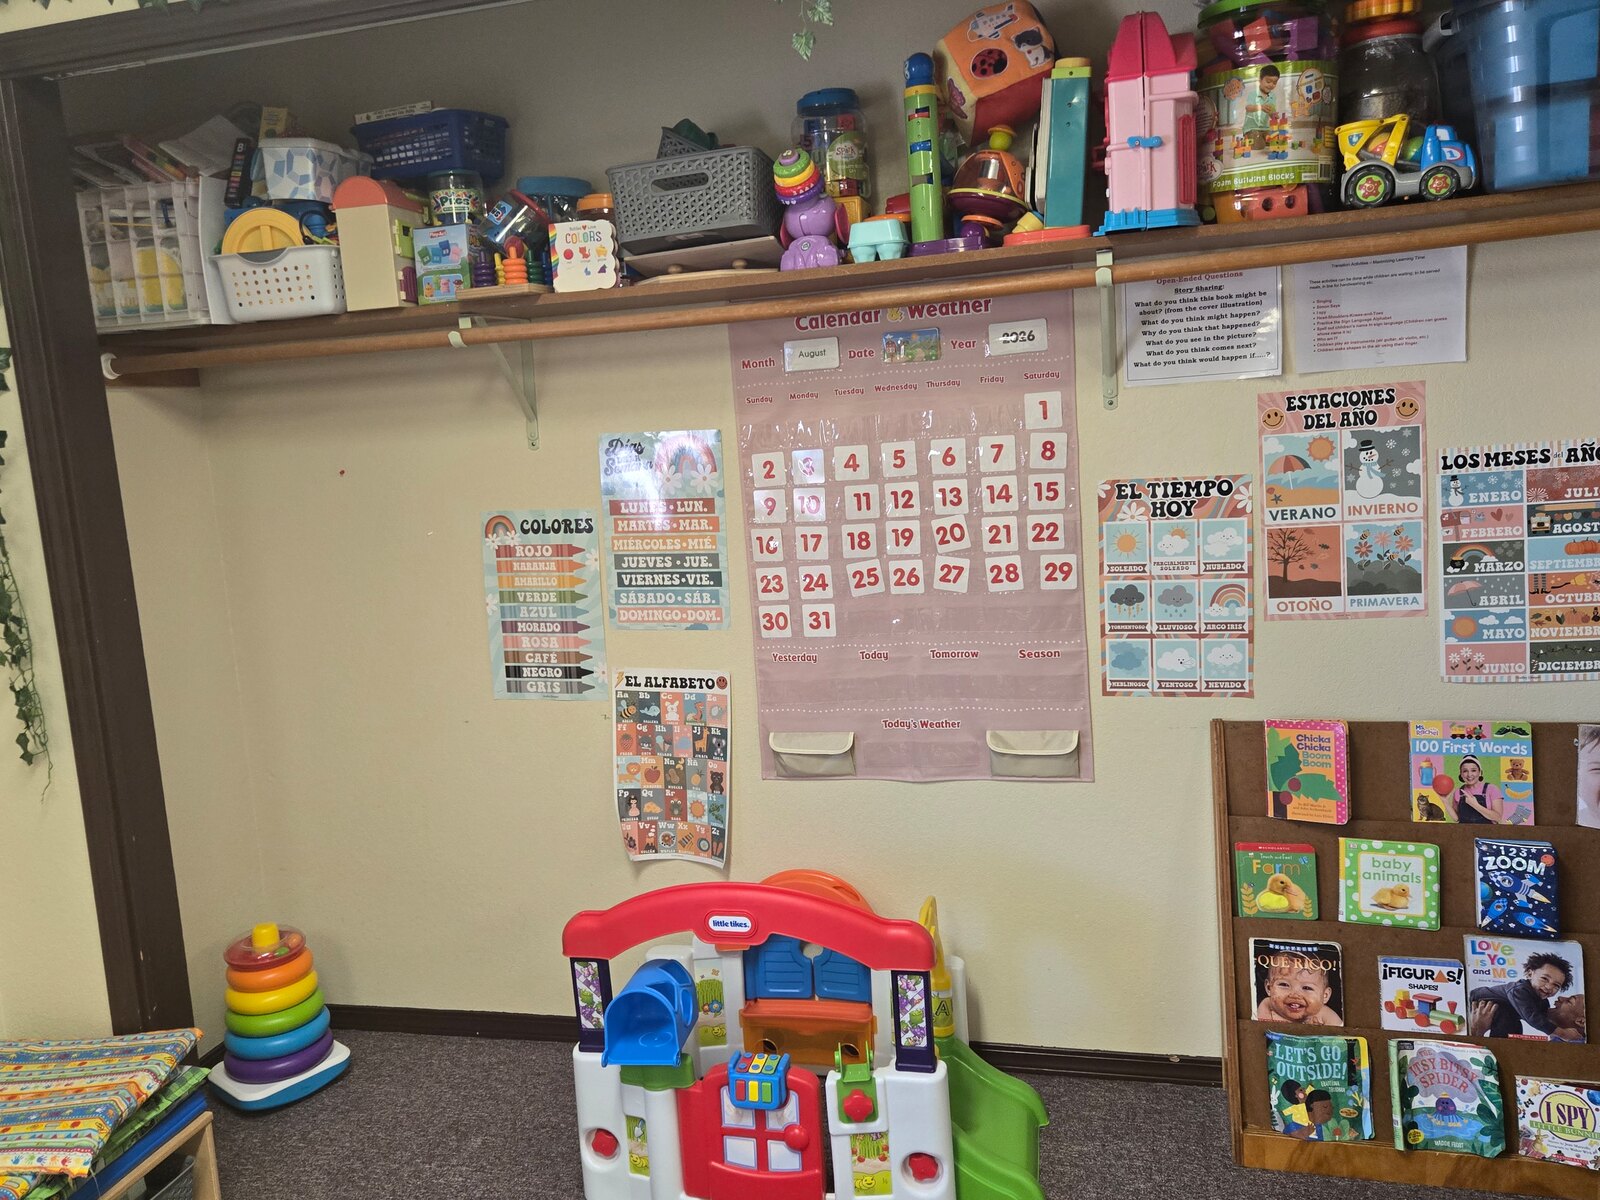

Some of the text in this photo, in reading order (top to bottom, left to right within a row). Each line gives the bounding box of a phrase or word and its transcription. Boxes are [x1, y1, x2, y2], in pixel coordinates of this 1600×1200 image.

[1234, 175, 1265, 185] Building
[566, 231, 602, 244] COLORS
[1157, 271, 1243, 284] Open-Ended Questions
[1196, 284, 1224, 292] Sharing:
[1236, 291, 1256, 300] might
[1220, 300, 1263, 309] illustration)
[795, 309, 881, 331] Calendar
[907, 298, 992, 319] Weather
[742, 330, 1035, 369] Month August Date Year 2026
[746, 370, 1060, 404] Sunday Monday Tuesday Wednesday Thursday Friday Saturday
[1286, 388, 1396, 412] ESTACIONES
[1039, 400, 1047, 420] 1
[1304, 407, 1378, 430] DEL AÑO
[763, 460, 775, 479] 2
[844, 454, 859, 472] 4
[893, 450, 905, 468] 5
[942, 447, 955, 466] 6
[991, 444, 1004, 463] 7
[1042, 440, 1055, 460] 8
[1441, 453, 1480, 471] LOS
[1484, 449, 1551, 468] MESES
[1554, 451, 1564, 459] del
[1116, 479, 1234, 500] EL TIEMPO
[1469, 490, 1522, 503] ENERO
[1150, 499, 1198, 518] HOY
[1269, 506, 1336, 522] VERANO
[1348, 502, 1418, 516] INVIERNO
[520, 518, 594, 535] COLORES
[1462, 526, 1523, 538] FEBRERO
[756, 522, 1059, 554] 16 17 18 19 20 21 22
[515, 545, 552, 557] ROJO
[513, 561, 556, 571] NARANJA
[1206, 562, 1240, 571] NUBLADO
[1474, 561, 1524, 572] MARZO
[514, 576, 557, 586] AMARILLO
[517, 592, 557, 602] VERDE
[1350, 595, 1419, 607] PRIMAVERA
[1479, 594, 1524, 606] ABRIL
[520, 606, 557, 618] AZUL
[1277, 598, 1332, 613] OTOÑO
[517, 622, 561, 632] MORADO
[762, 612, 830, 631] 30 31
[1482, 629, 1525, 640] MAYO
[522, 637, 559, 648] ROSA
[525, 648, 557, 663] CAFÉ
[773, 649, 1061, 664] Yesterday Today Tomorrow Season
[522, 667, 562, 677] NEGRO
[1482, 663, 1526, 674] JUNIO
[526, 682, 560, 693] GRIS
[625, 676, 715, 690] EL ALFABETO
[1209, 681, 1241, 689] NEVADO
[883, 719, 961, 729] Today's Weather
[1296, 734, 1331, 743] Chicka
[1297, 743, 1331, 752] Chicka
[1416, 741, 1528, 755] 100 First Words
[1302, 751, 1331, 759] Boom
[1302, 760, 1331, 768] Boom
[1500, 846, 1527, 857] 1 2 3
[1252, 860, 1300, 875] Farm
[1372, 857, 1412, 872] baby
[1483, 856, 1546, 875] ZOOM
[1362, 870, 1421, 884] animals
[1408, 983, 1438, 991] SHAPES!
[935, 1000, 950, 1016] A
[1275, 1043, 1341, 1063] LET'S GO
[1276, 1061, 1347, 1081] OUTSIDE!
[1409, 1058, 1479, 1081] ITSY BITSY
[1420, 1072, 1469, 1093] SPIDER
[1545, 1101, 1589, 1130] I SPY
[1533, 1122, 1562, 1132] LITTLE
